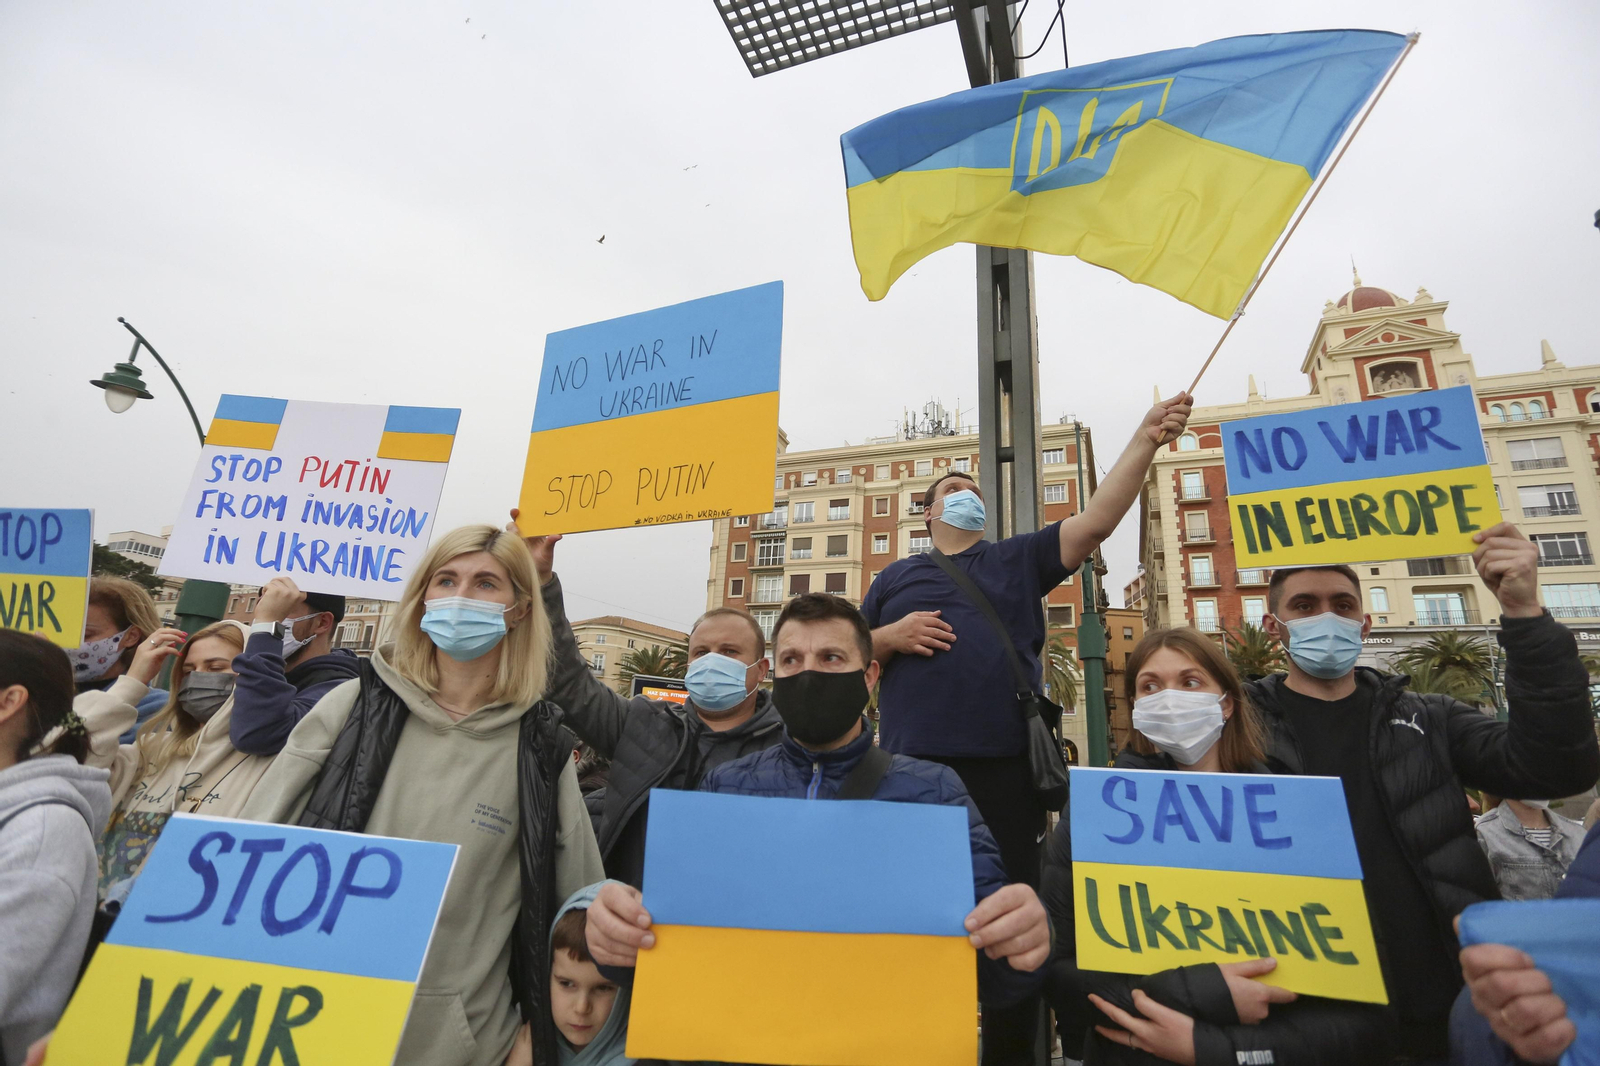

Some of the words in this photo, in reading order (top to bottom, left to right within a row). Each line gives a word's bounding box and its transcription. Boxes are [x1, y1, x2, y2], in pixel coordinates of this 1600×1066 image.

[550, 357, 588, 394] NO
[605, 339, 666, 382] WAR
[690, 329, 718, 359] IN
[600, 376, 695, 418] UKRAINE
[205, 454, 282, 483] STOP
[1233, 426, 1308, 480] NO
[1317, 405, 1462, 464] WAR
[195, 489, 288, 522] FROM
[544, 469, 613, 516] STOP
[636, 461, 715, 505] PUTIN
[656, 513, 683, 522] VODKA
[697, 508, 732, 518] UKRAINE
[1236, 500, 1294, 554] IN
[1295, 483, 1483, 545] EUROPE
[0, 511, 63, 564] TOP
[1101, 775, 1293, 850] SAVE
[143, 830, 403, 937] STOP
[1085, 876, 1360, 965] UKRAINE
[123, 974, 324, 1066] WAR
[1236, 1050, 1274, 1065] PUMA
